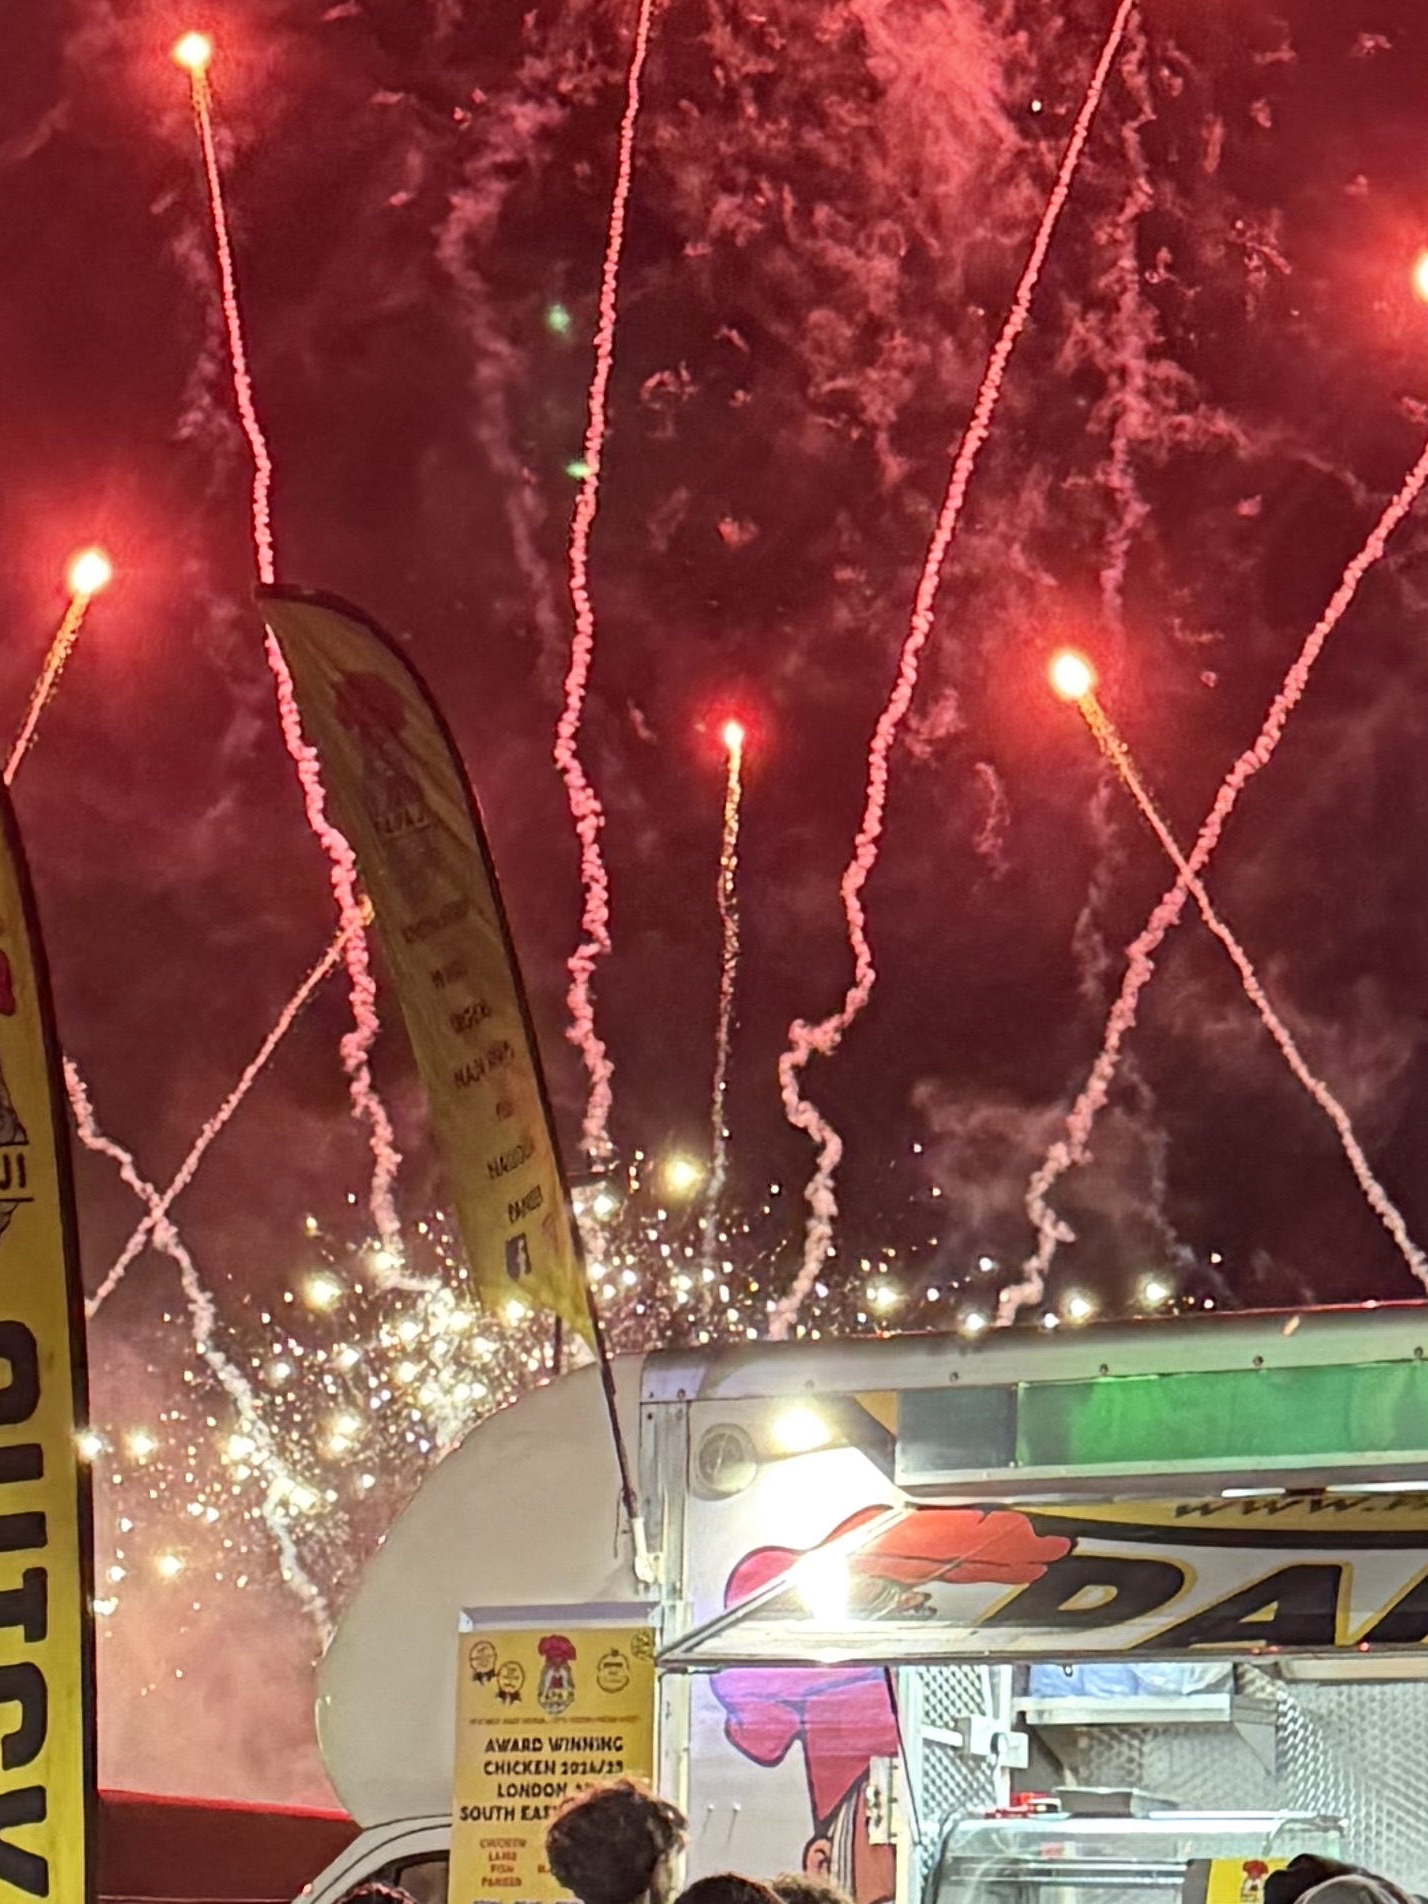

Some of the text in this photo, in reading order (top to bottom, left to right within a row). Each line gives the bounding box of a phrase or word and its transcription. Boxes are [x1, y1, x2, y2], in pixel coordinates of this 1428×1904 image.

[484, 1736, 625, 1754] AWARD WINNING
[482, 1759, 557, 1777] CHICKEN
[496, 1781, 569, 1799] LONDON
[459, 1804, 516, 1822] SOUTH
